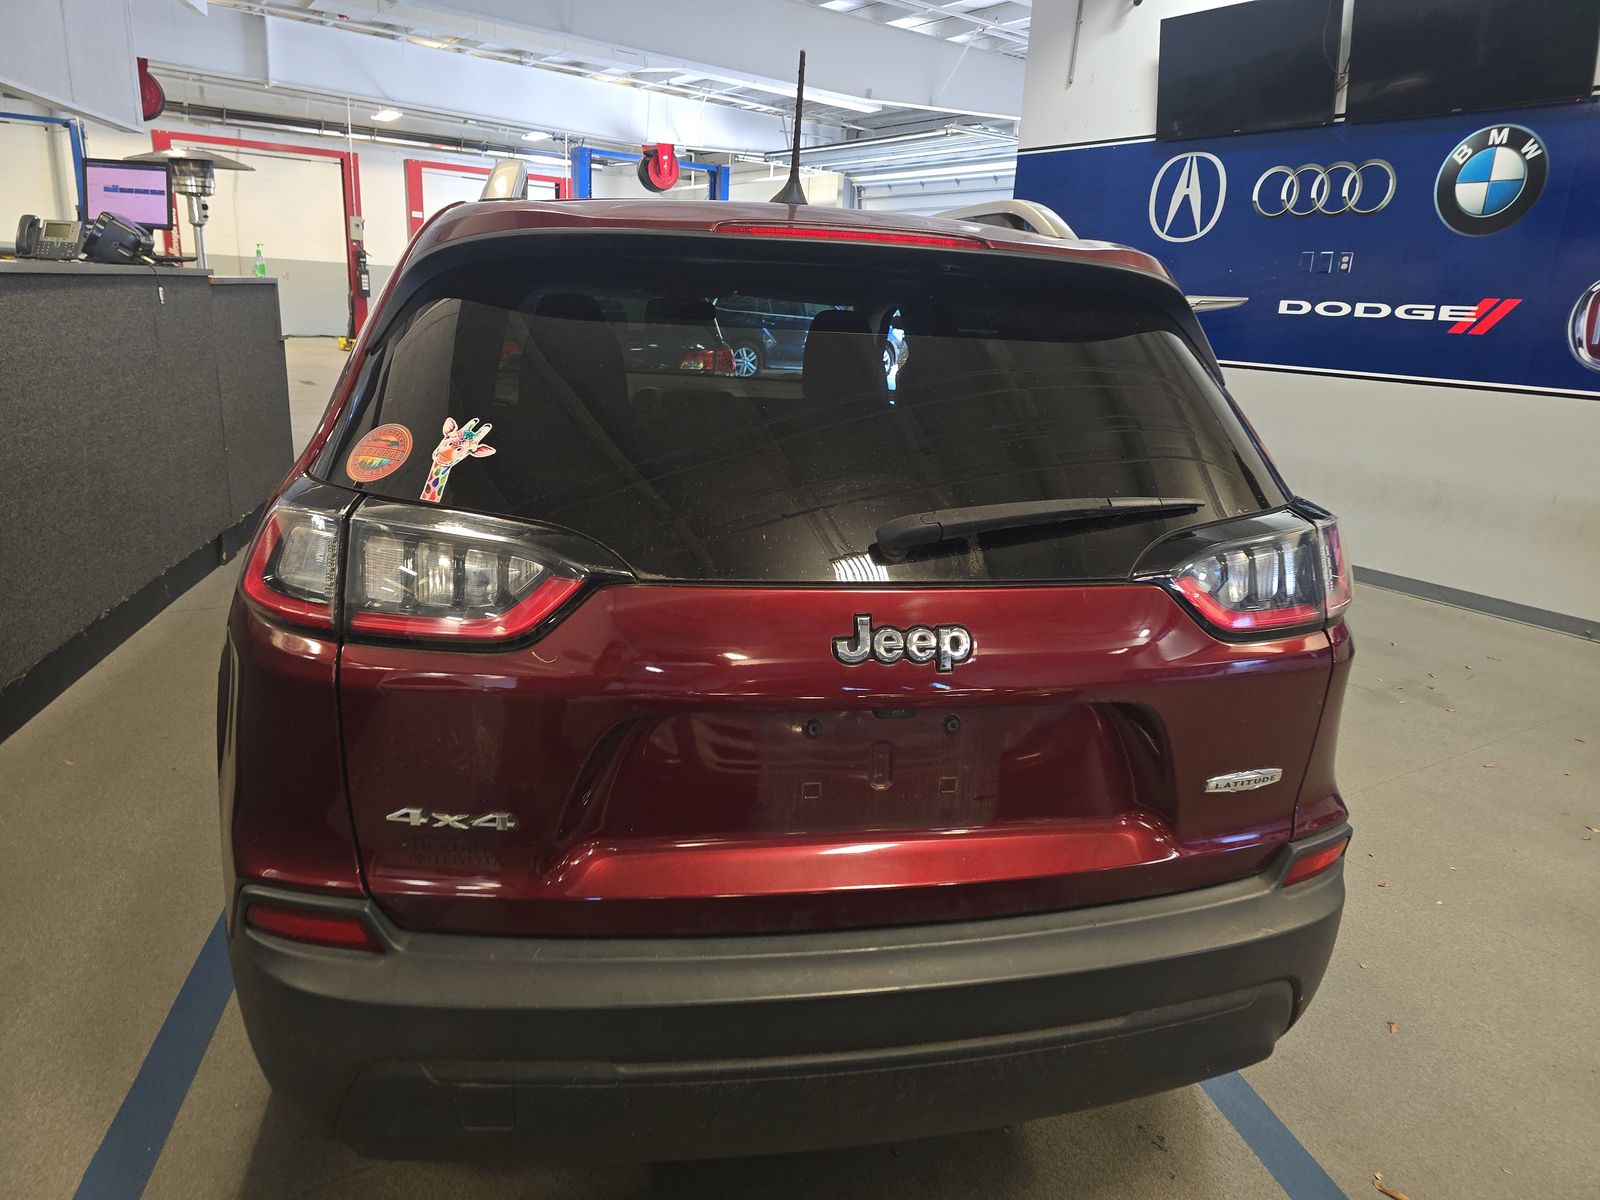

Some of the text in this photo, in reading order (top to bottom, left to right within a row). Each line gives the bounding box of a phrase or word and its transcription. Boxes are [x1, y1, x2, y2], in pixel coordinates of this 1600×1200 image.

[1452, 127, 1543, 166] BMW
[1277, 299, 1479, 322] DODGE
[833, 614, 973, 672] Jeep
[1214, 774, 1277, 789] LATITUDE
[385, 807, 516, 831] 4x4
